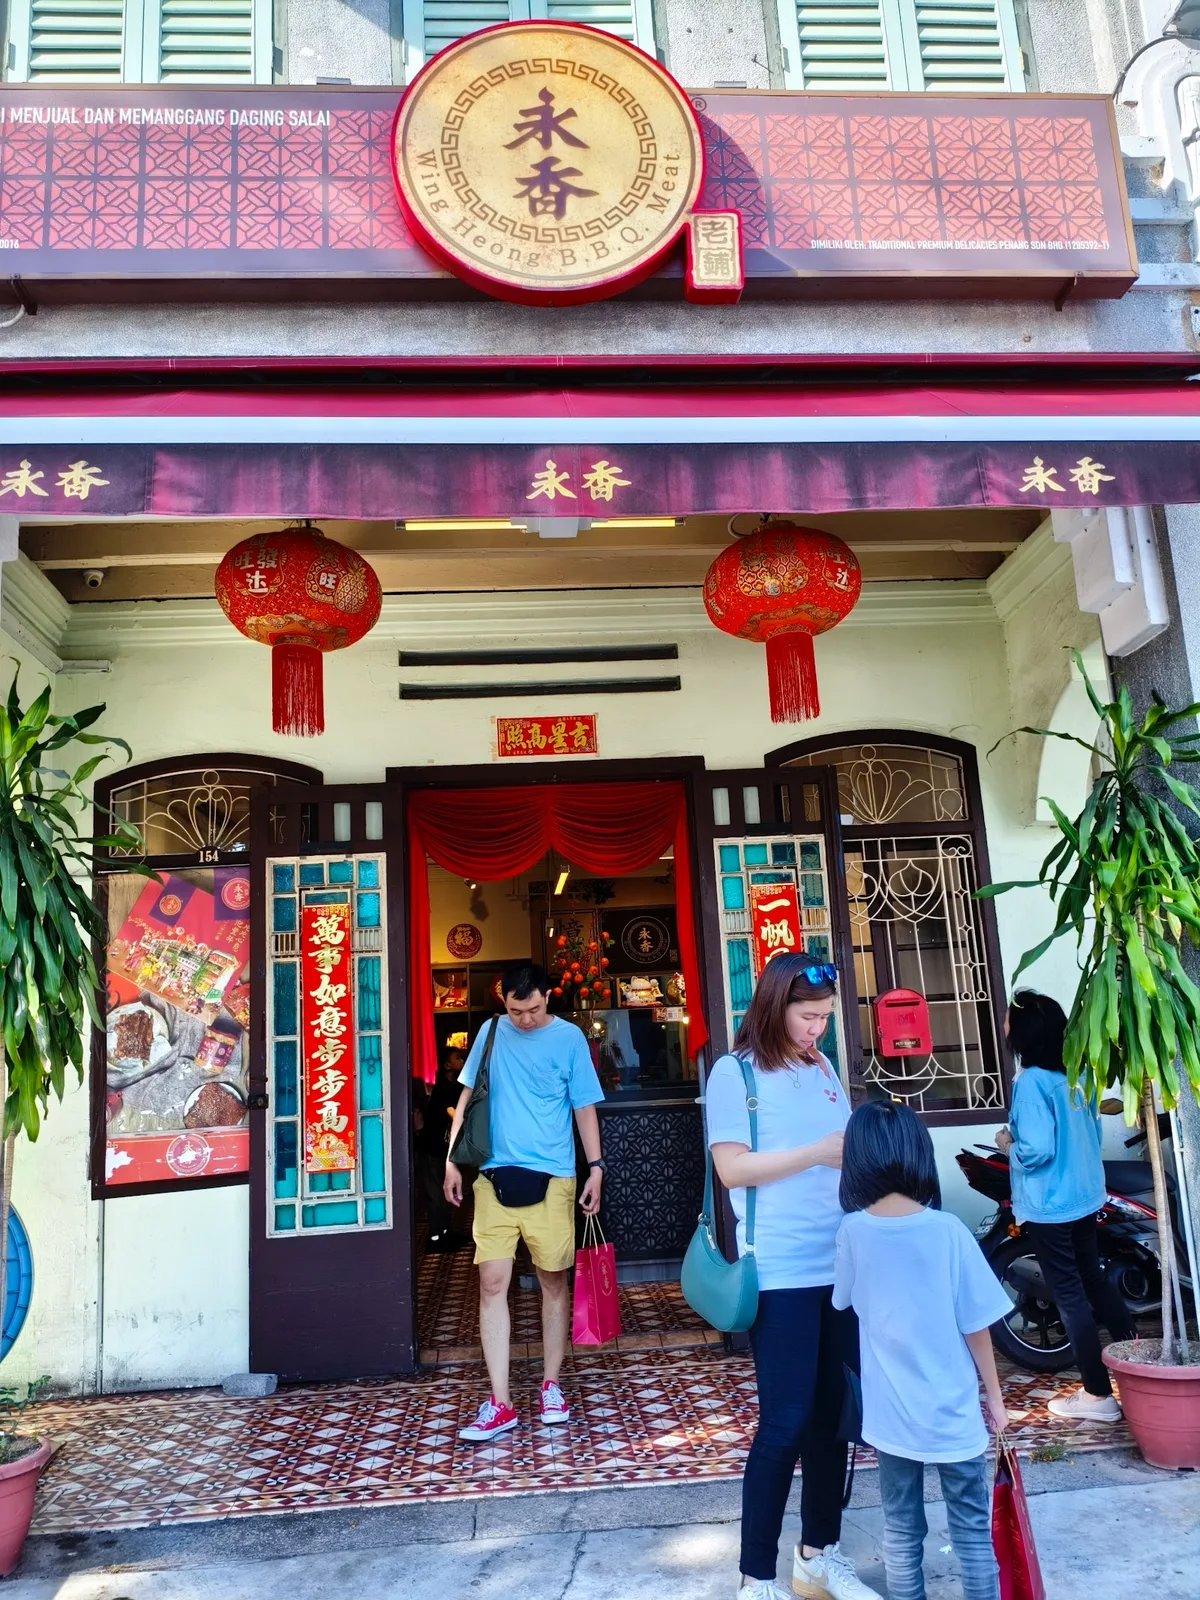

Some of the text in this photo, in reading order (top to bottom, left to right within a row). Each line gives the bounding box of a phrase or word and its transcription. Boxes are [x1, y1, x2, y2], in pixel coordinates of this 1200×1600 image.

[11, 107, 80, 124] MENJUAL
[84, 108, 115, 125] DAN
[118, 108, 225, 126] MEMANGGANG
[229, 109, 284, 126] DAGING
[288, 110, 330, 126] SALAI
[502, 86, 600, 222] 永香
[416, 149, 681, 268] Wing Heong B.B.Q. Meat
[811, 239, 843, 249] DIMILIKI
[867, 240, 916, 249] TRADITIONAL
[917, 240, 953, 250] PREMIUM
[954, 240, 997, 250] DELICACIES
[999, 240, 1029, 250] PENANG
[1030, 240, 1045, 250] SDN
[1047, 240, 1063, 250] BHD
[0, 459, 110, 500] 永香
[526, 459, 631, 502] 永香
[1018, 456, 1116, 495] 永香
[319, 571, 337, 590] 旺
[198, 851, 219, 862] 154
[637, 927, 655, 953] 永香
[757, 898, 796, 962] 一帆
[308, 914, 349, 1132] 萬事如意步步高
